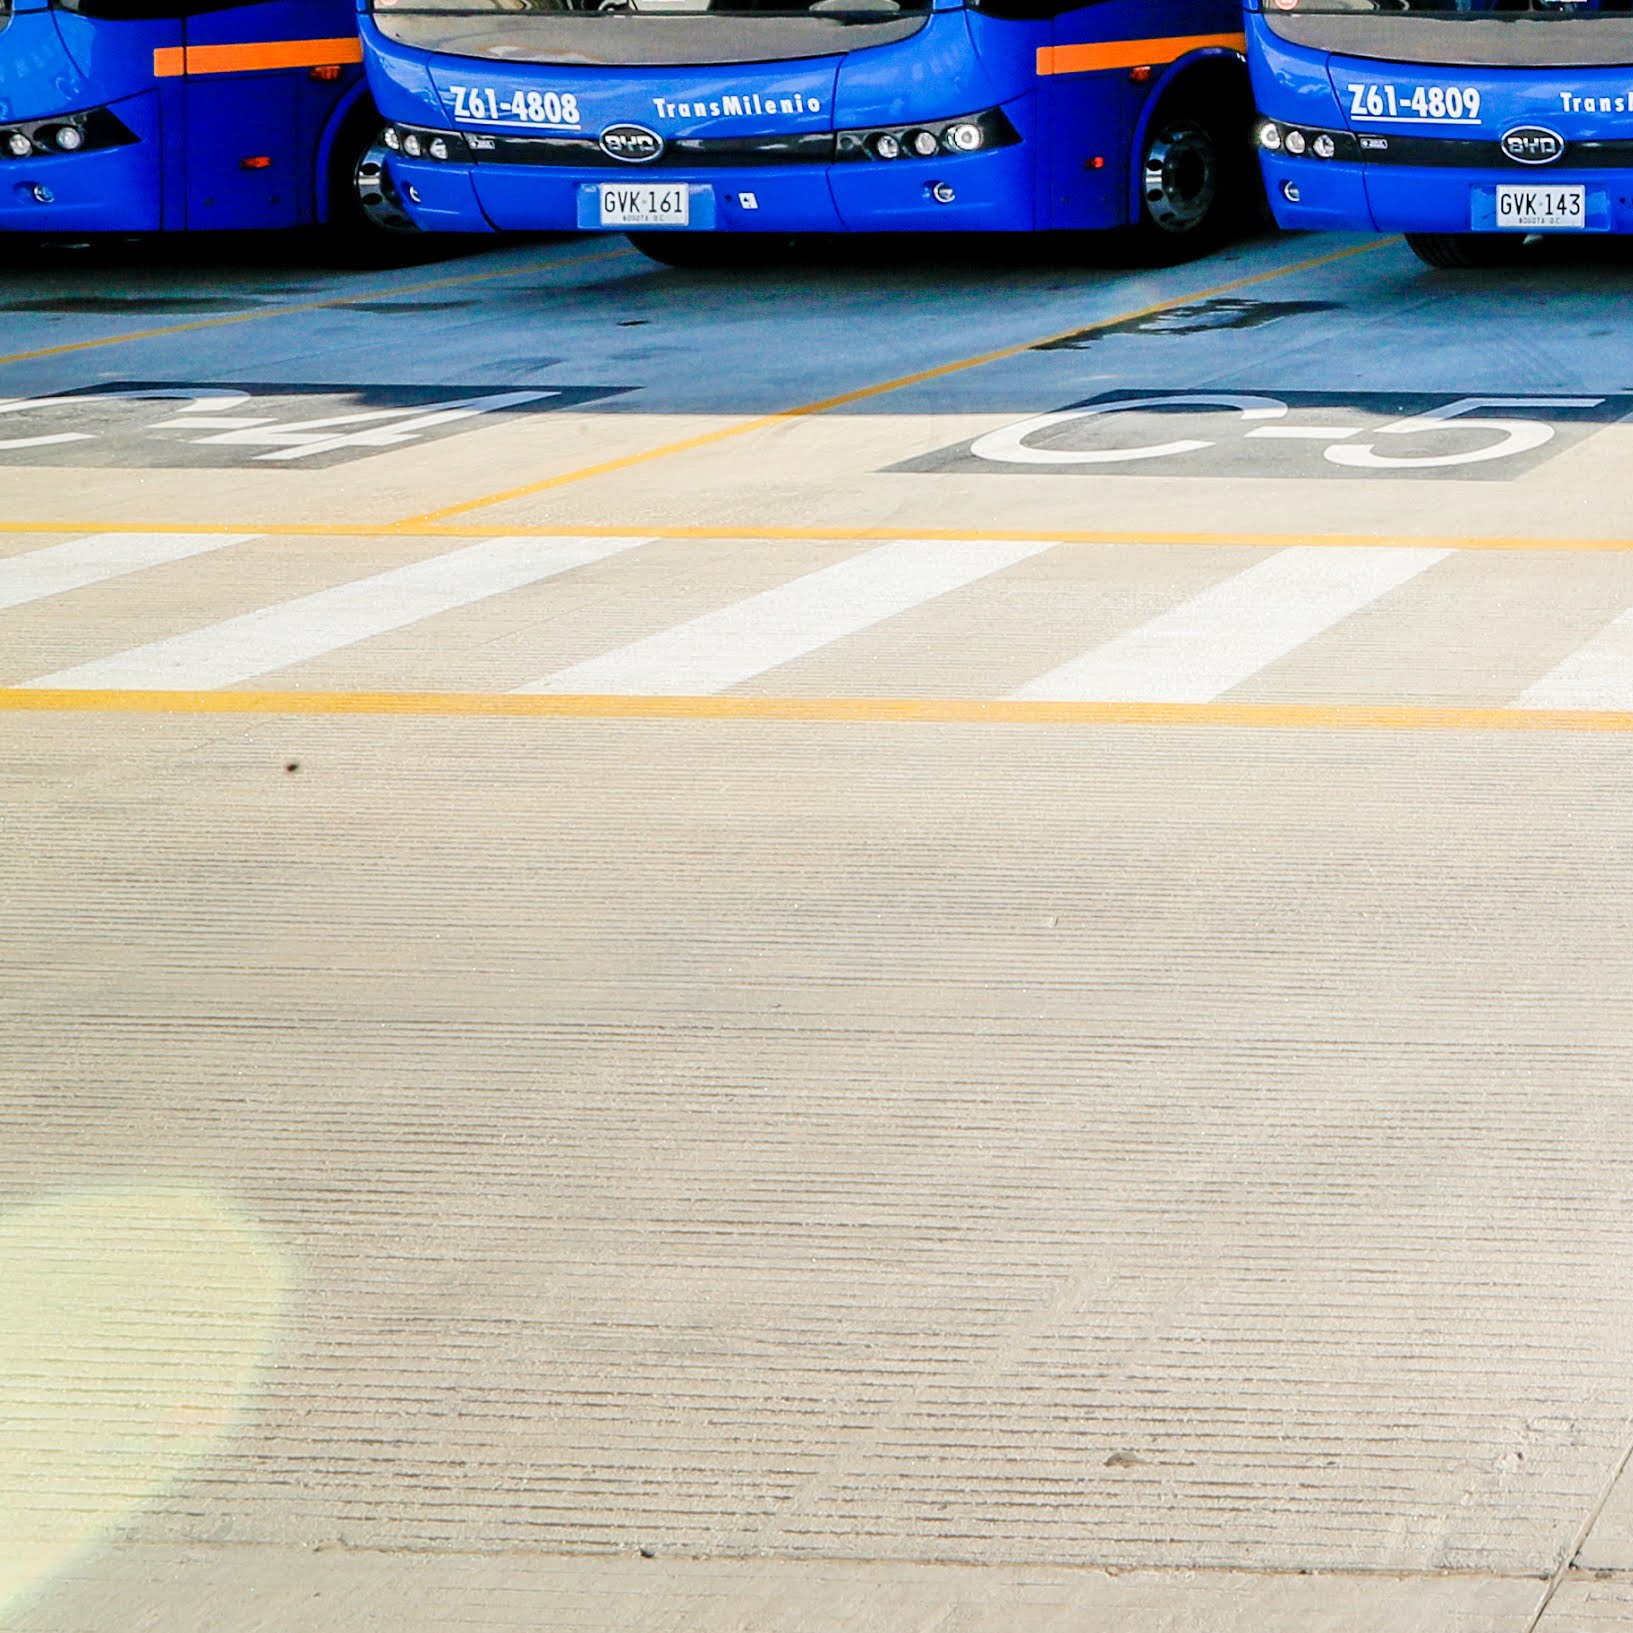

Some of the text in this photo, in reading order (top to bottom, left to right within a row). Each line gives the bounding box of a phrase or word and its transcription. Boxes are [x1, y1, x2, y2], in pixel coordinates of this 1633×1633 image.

[450, 85, 822, 125] Z61-4808 TransMilenio
[1347, 83, 1481, 119] Z61-4809
[604, 134, 656, 152] BYD
[1506, 136, 1557, 154] BYD
[970, 393, 1606, 469] C-5
